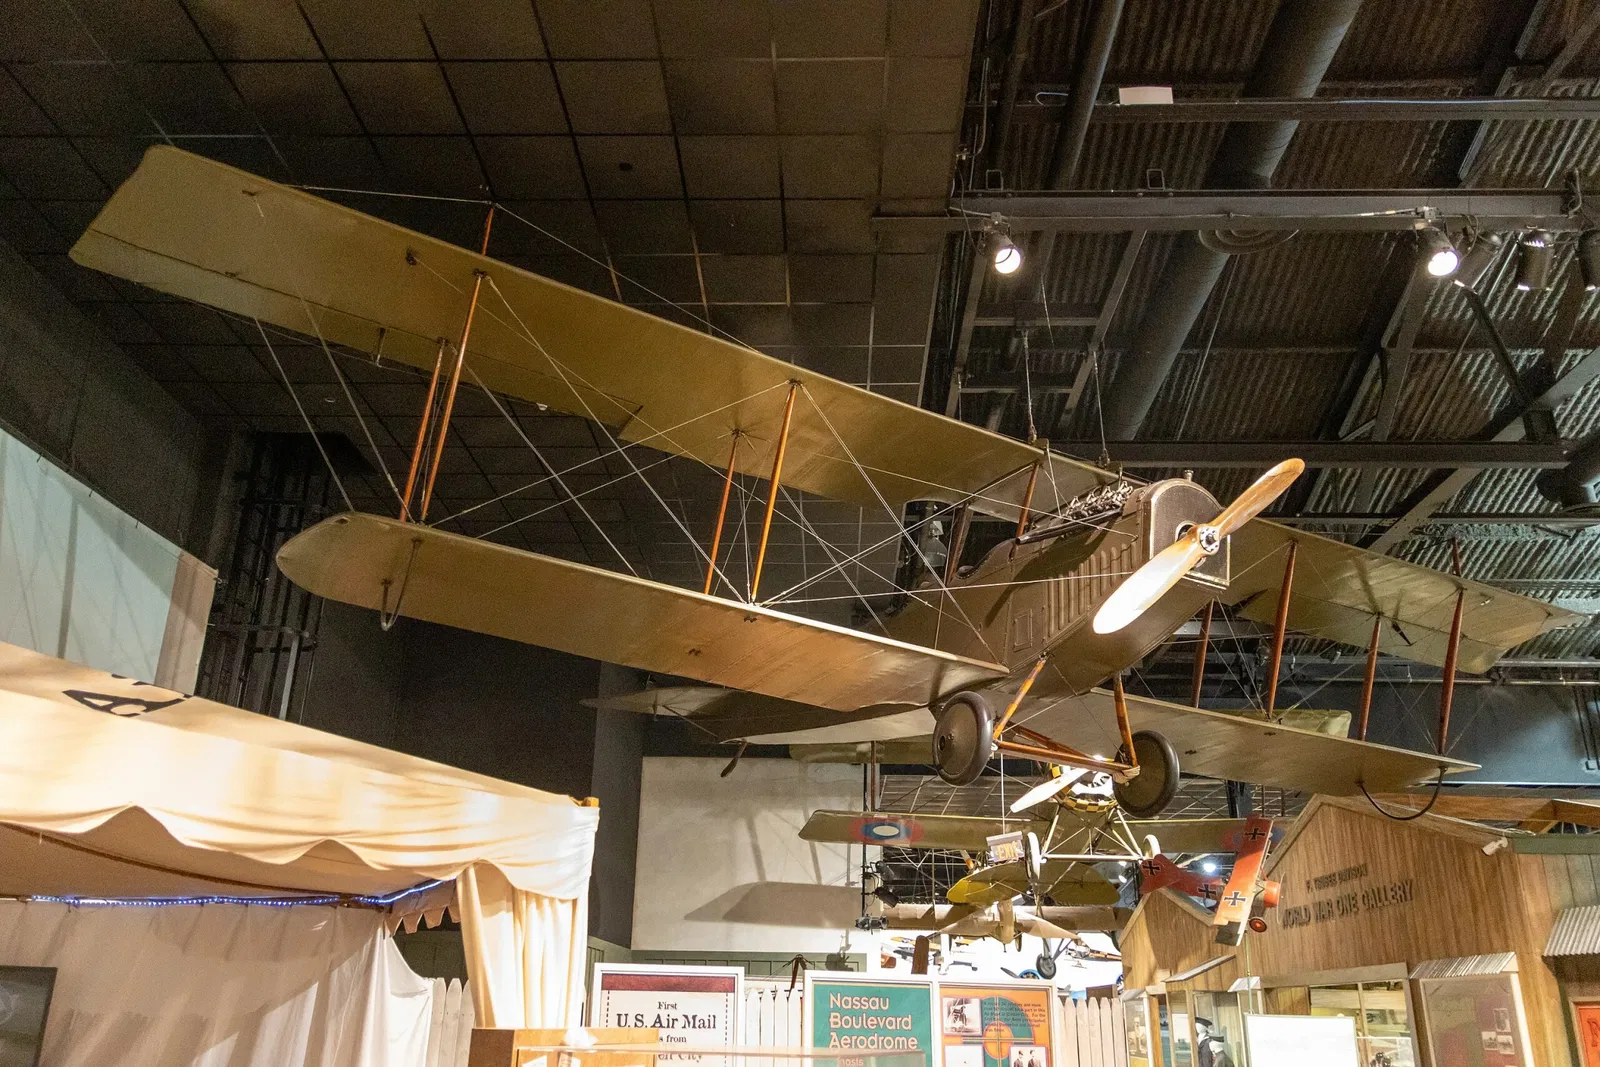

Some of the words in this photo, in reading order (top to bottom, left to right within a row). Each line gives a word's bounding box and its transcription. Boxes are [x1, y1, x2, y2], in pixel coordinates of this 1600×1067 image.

[1313, 900, 1334, 922] WAR
[1337, 893, 1357, 915] ONE
[1362, 880, 1413, 910] GALLERY
[657, 1001, 677, 1010] First
[829, 992, 889, 1010] Nassau
[650, 1014, 678, 1029] Air
[681, 1014, 716, 1029] Mail
[829, 1012, 912, 1031] Boulevard
[666, 1034, 687, 1043] from
[829, 1032, 918, 1051] Aerodrome
